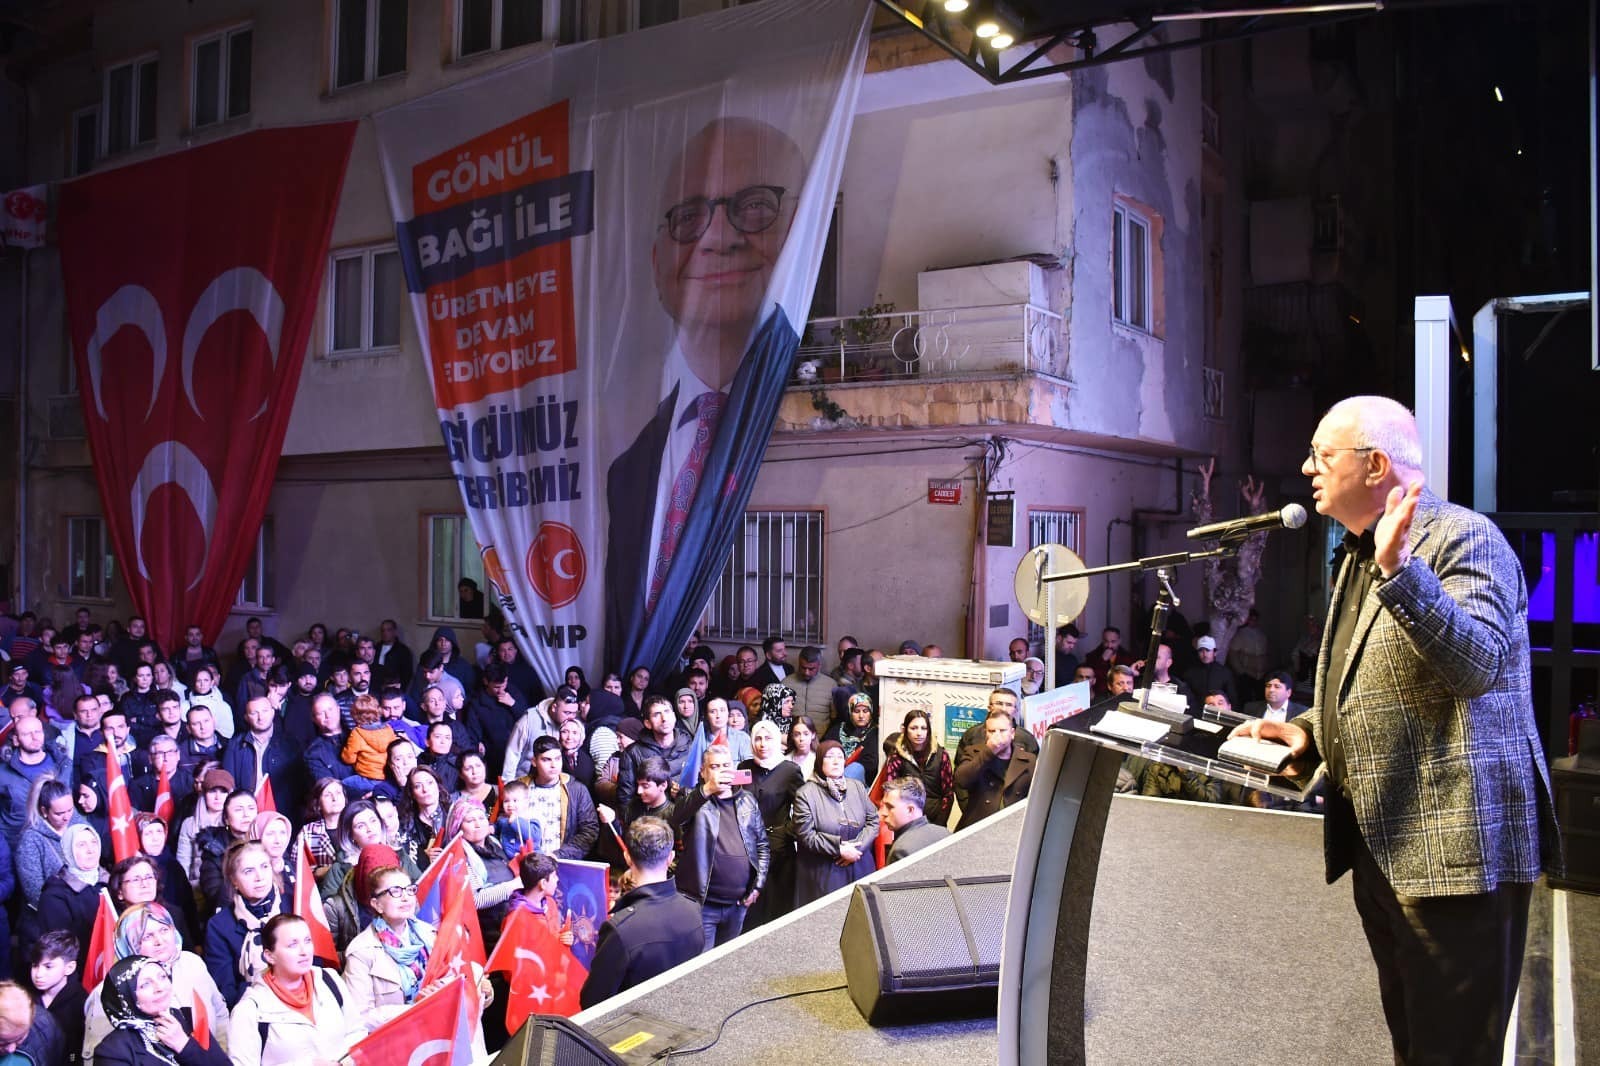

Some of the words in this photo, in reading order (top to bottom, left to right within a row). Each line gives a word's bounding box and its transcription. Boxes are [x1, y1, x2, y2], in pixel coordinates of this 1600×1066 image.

[427, 133, 553, 202] GÖNÜL
[417, 208, 503, 269] BAĞI
[515, 192, 572, 240] İLE
[431, 269, 557, 321] ÜRETMEYE
[455, 309, 534, 350] DEVAM
